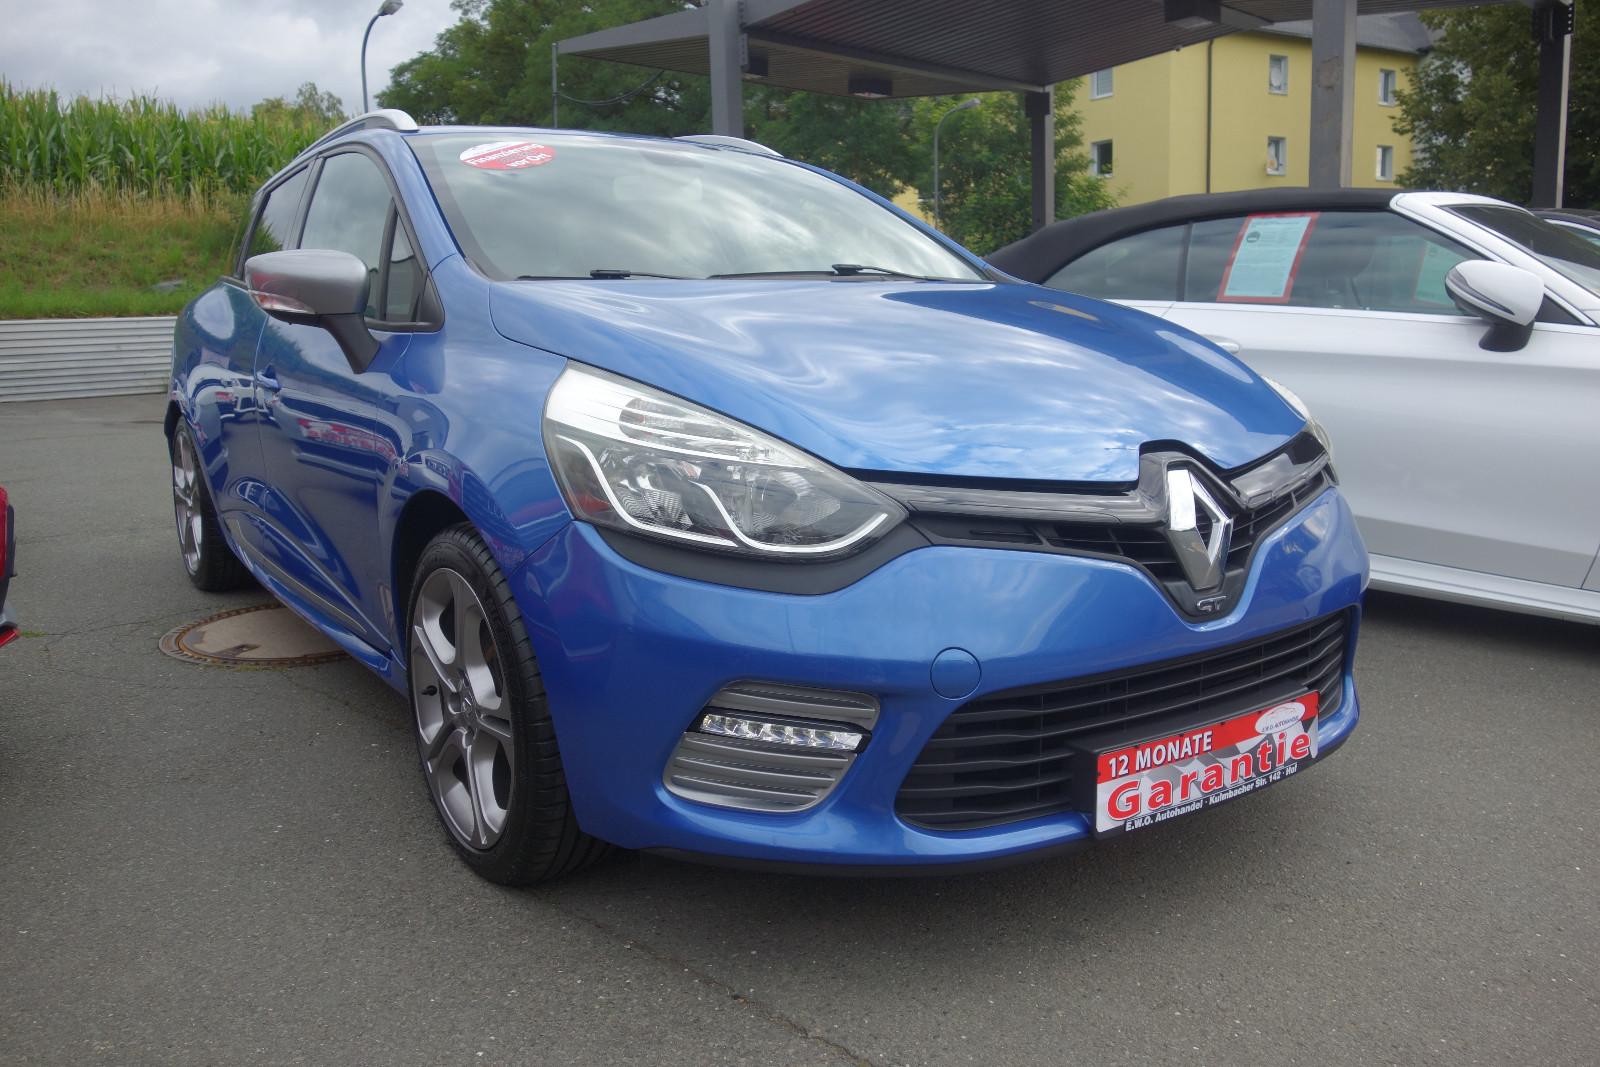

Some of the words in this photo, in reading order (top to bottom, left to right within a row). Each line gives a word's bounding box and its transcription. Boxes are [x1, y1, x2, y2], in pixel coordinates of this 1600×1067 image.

[1197, 596, 1227, 611] GT
[1107, 732, 1311, 821] Garantie
[1109, 755, 1129, 777] 12
[1135, 731, 1214, 771] MONATE
[1125, 813, 1154, 832] E.W.O.
[1155, 800, 1203, 822] Autohandel
[1209, 783, 1254, 804] Kulmbacher
[1255, 777, 1267, 789] Str.
[1269, 771, 1281, 784] 142
[1285, 764, 1297, 775] Hof
